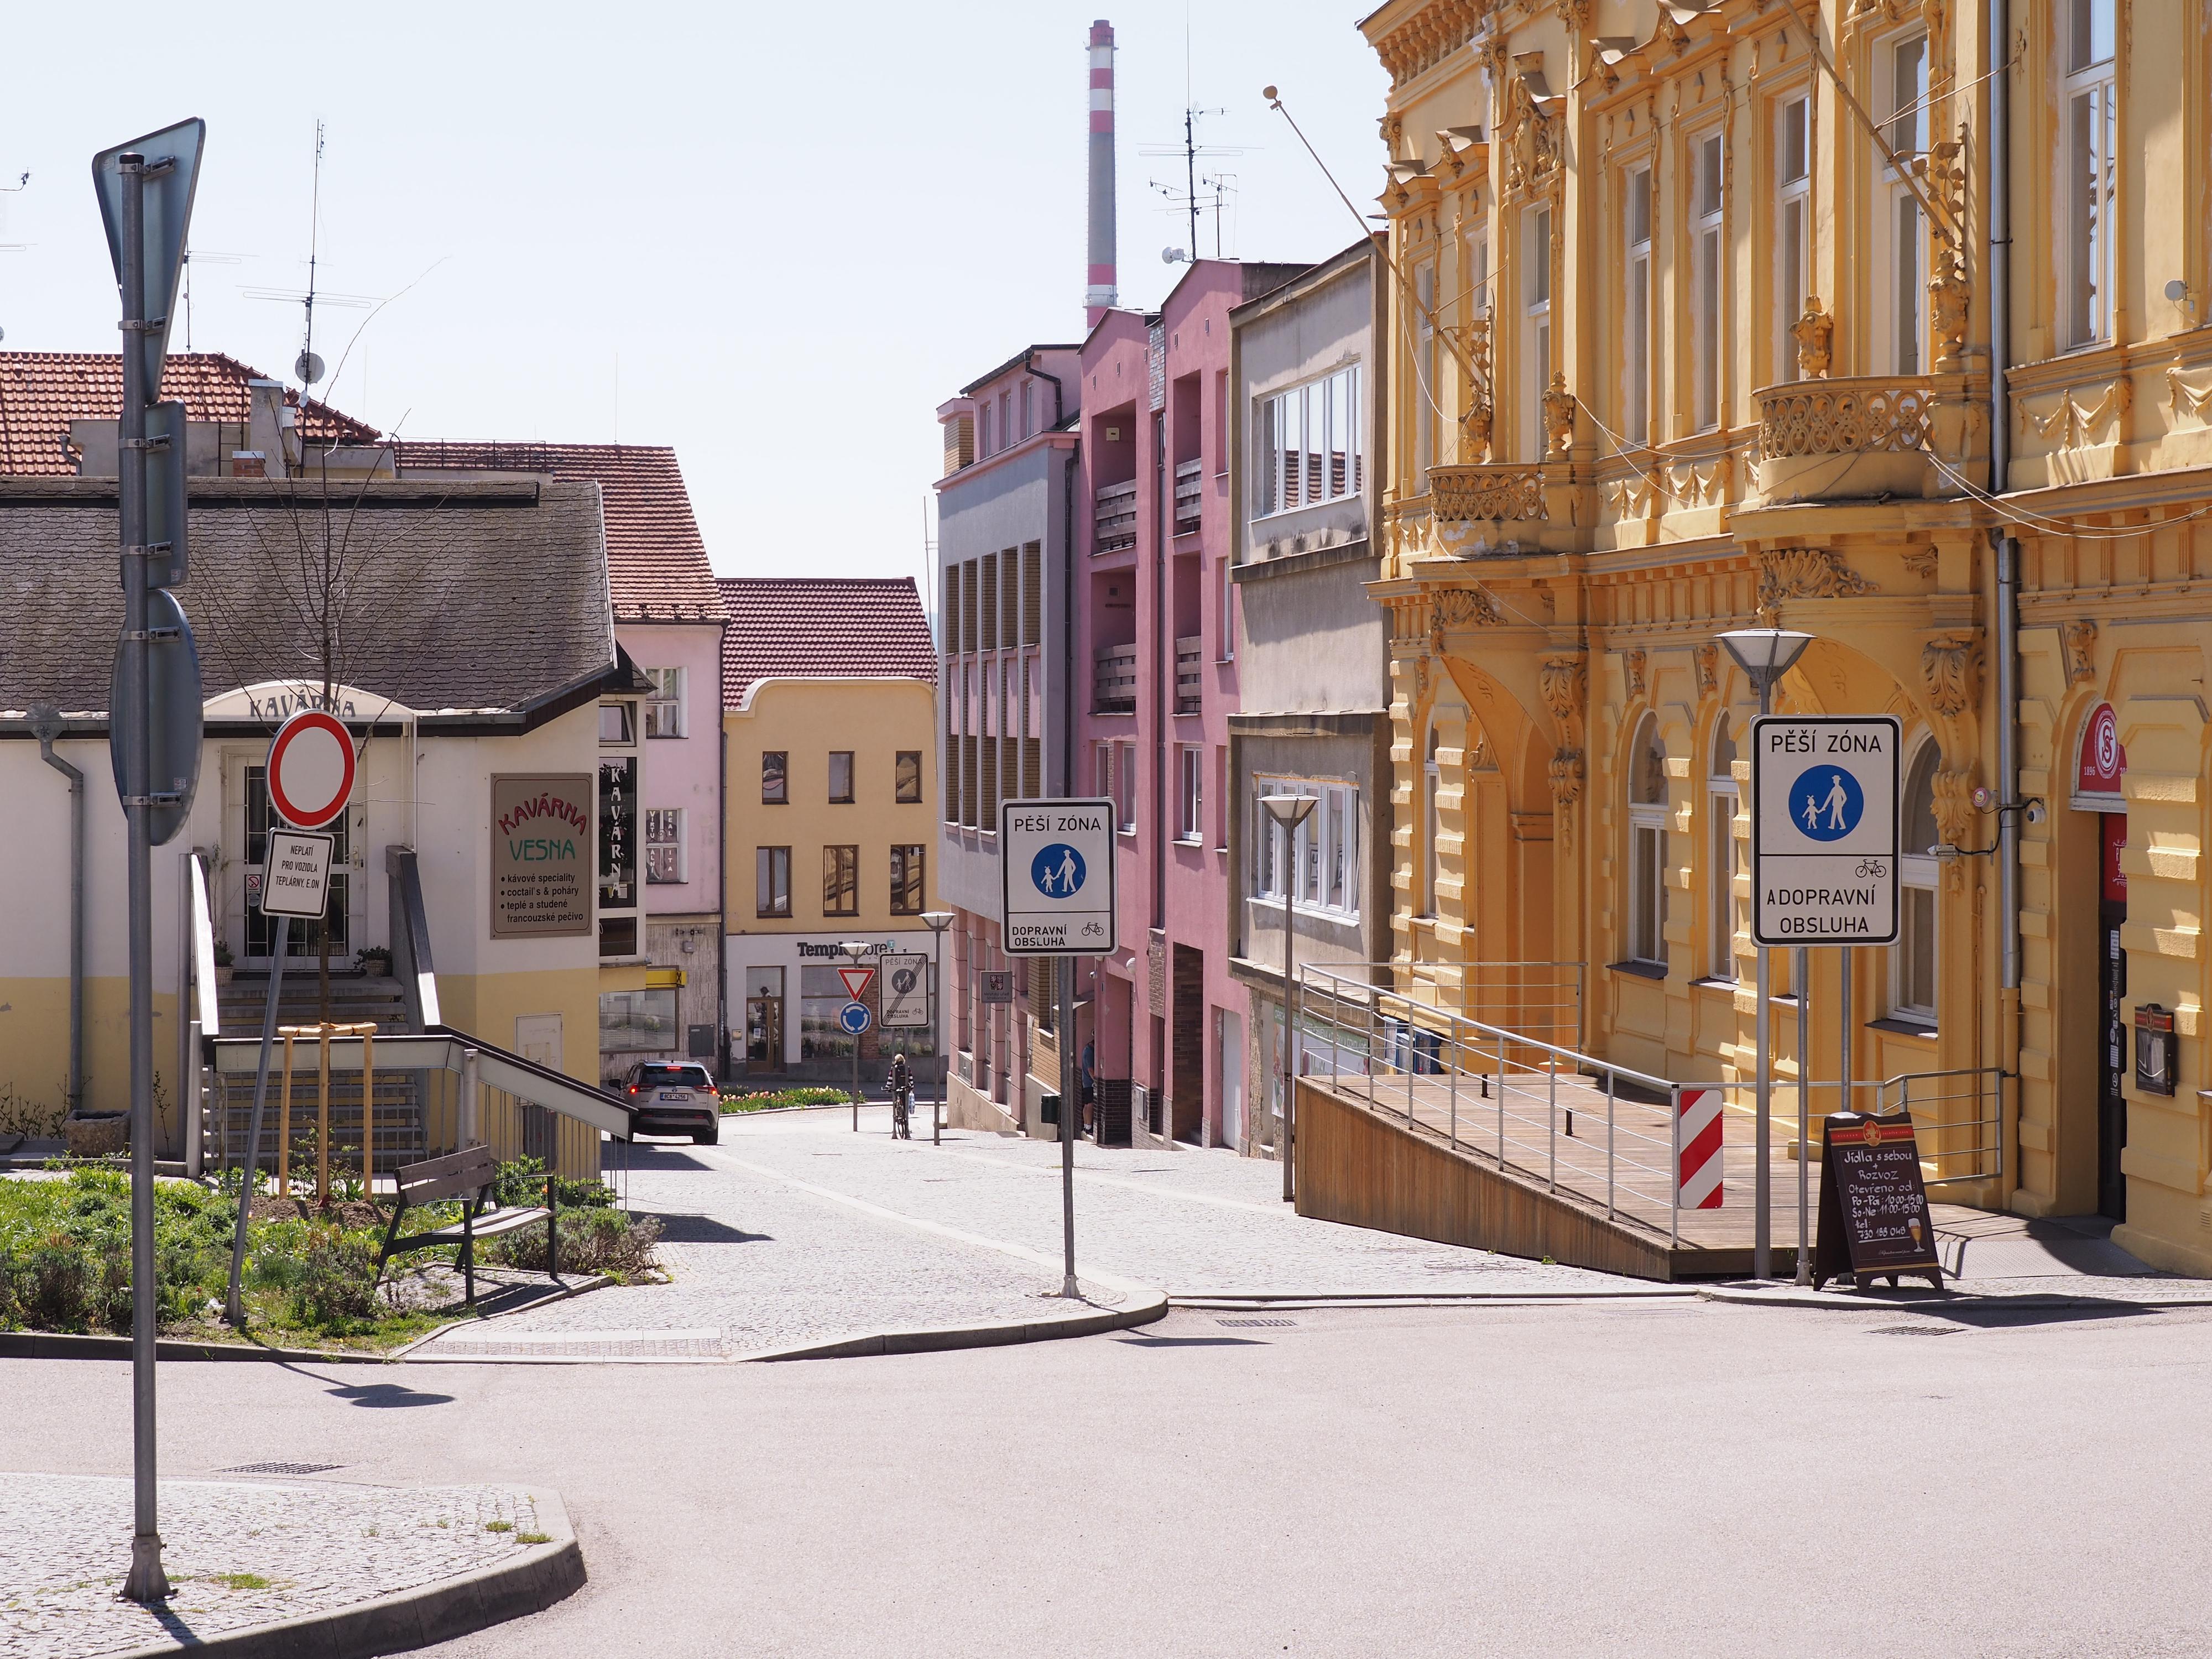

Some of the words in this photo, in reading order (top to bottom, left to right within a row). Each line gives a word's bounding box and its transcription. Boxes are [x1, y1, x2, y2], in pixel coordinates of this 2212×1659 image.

[1771, 729, 1817, 753] PĚŠÍ
[1827, 729, 1882, 753] ZÓNA
[2084, 766, 2095, 776] 1896
[498, 792, 587, 836] KAVÁRNA
[1014, 815, 1050, 832] PĚŠÍ
[1057, 815, 1102, 831] ZÓNA
[290, 845, 314, 857] NEPLATÍ
[510, 839, 576, 861] VESNA
[281, 860, 293, 870] PRO
[295, 862, 318, 873] VOZIDLA
[276, 875, 305, 888] TEPLÁRNY,
[306, 879, 320, 889] E.ON
[508, 873, 536, 883] kávové
[538, 873, 575, 884] speciality
[544, 886, 549, 895] &
[552, 886, 579, 897] poháry
[507, 900, 526, 911] teplé
[536, 899, 568, 909] studené
[507, 912, 555, 923] francouzské
[558, 911, 583, 923] pečivo
[1013, 924, 1067, 936] DOPRAVNÍ
[1780, 916, 1869, 933] OBSLUHA
[1014, 937, 1066, 946] OBSLUHA
[853, 941, 888, 956] ore
[885, 957, 901, 966] PĚŠÍ
[1844, 1150, 1872, 1163] Jídla
[1884, 1150, 1912, 1161] sebou
[1857, 1229, 1874, 1239] 730
[1890, 1226, 1906, 1236] 048
